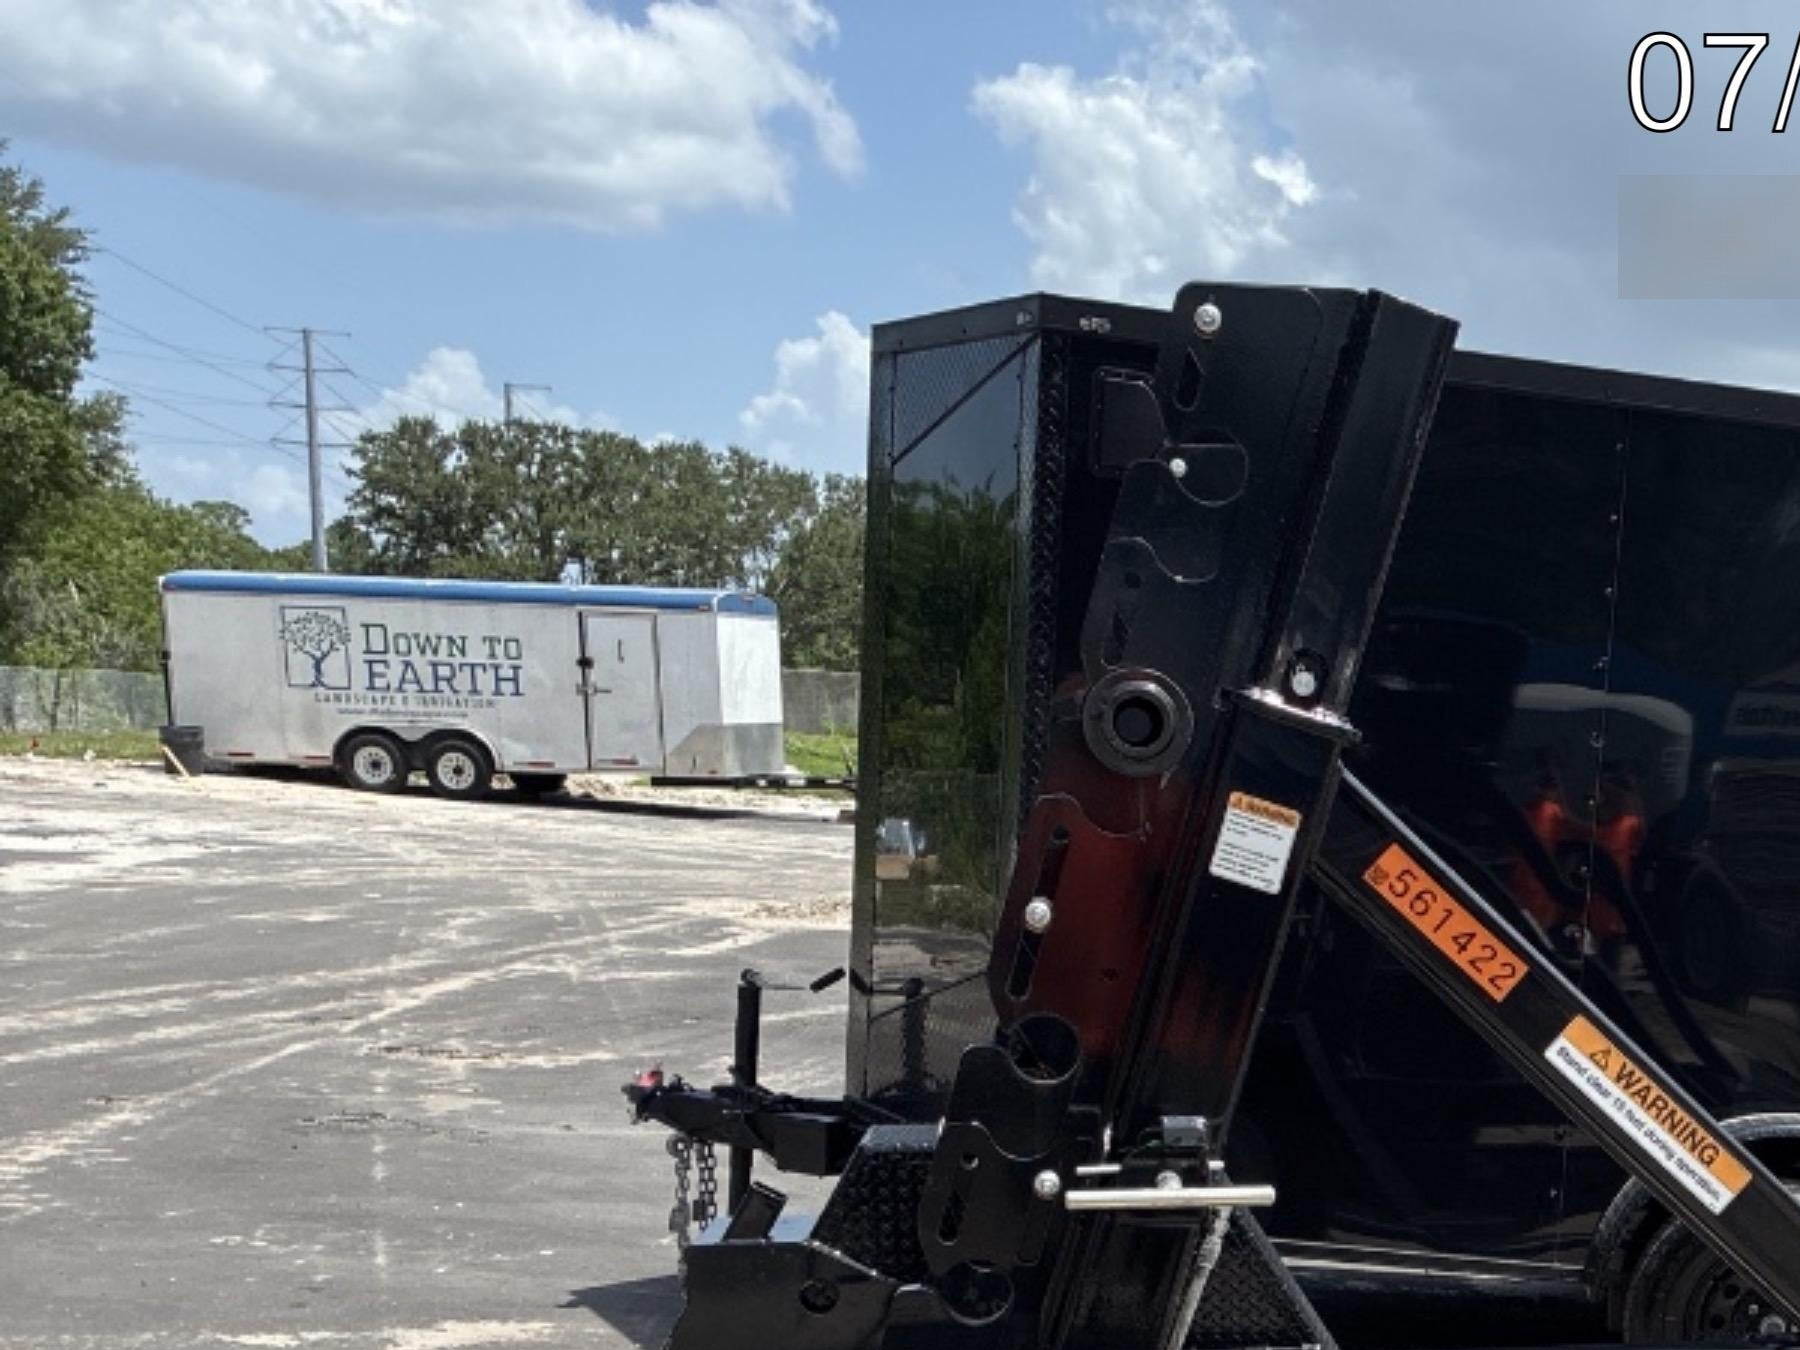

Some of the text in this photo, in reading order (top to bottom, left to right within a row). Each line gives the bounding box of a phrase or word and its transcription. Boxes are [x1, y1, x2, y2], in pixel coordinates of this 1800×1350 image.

[362, 659, 525, 697] EARTH
[1388, 868, 1517, 991] 561422
[1614, 1062, 1720, 1168] WARNING
